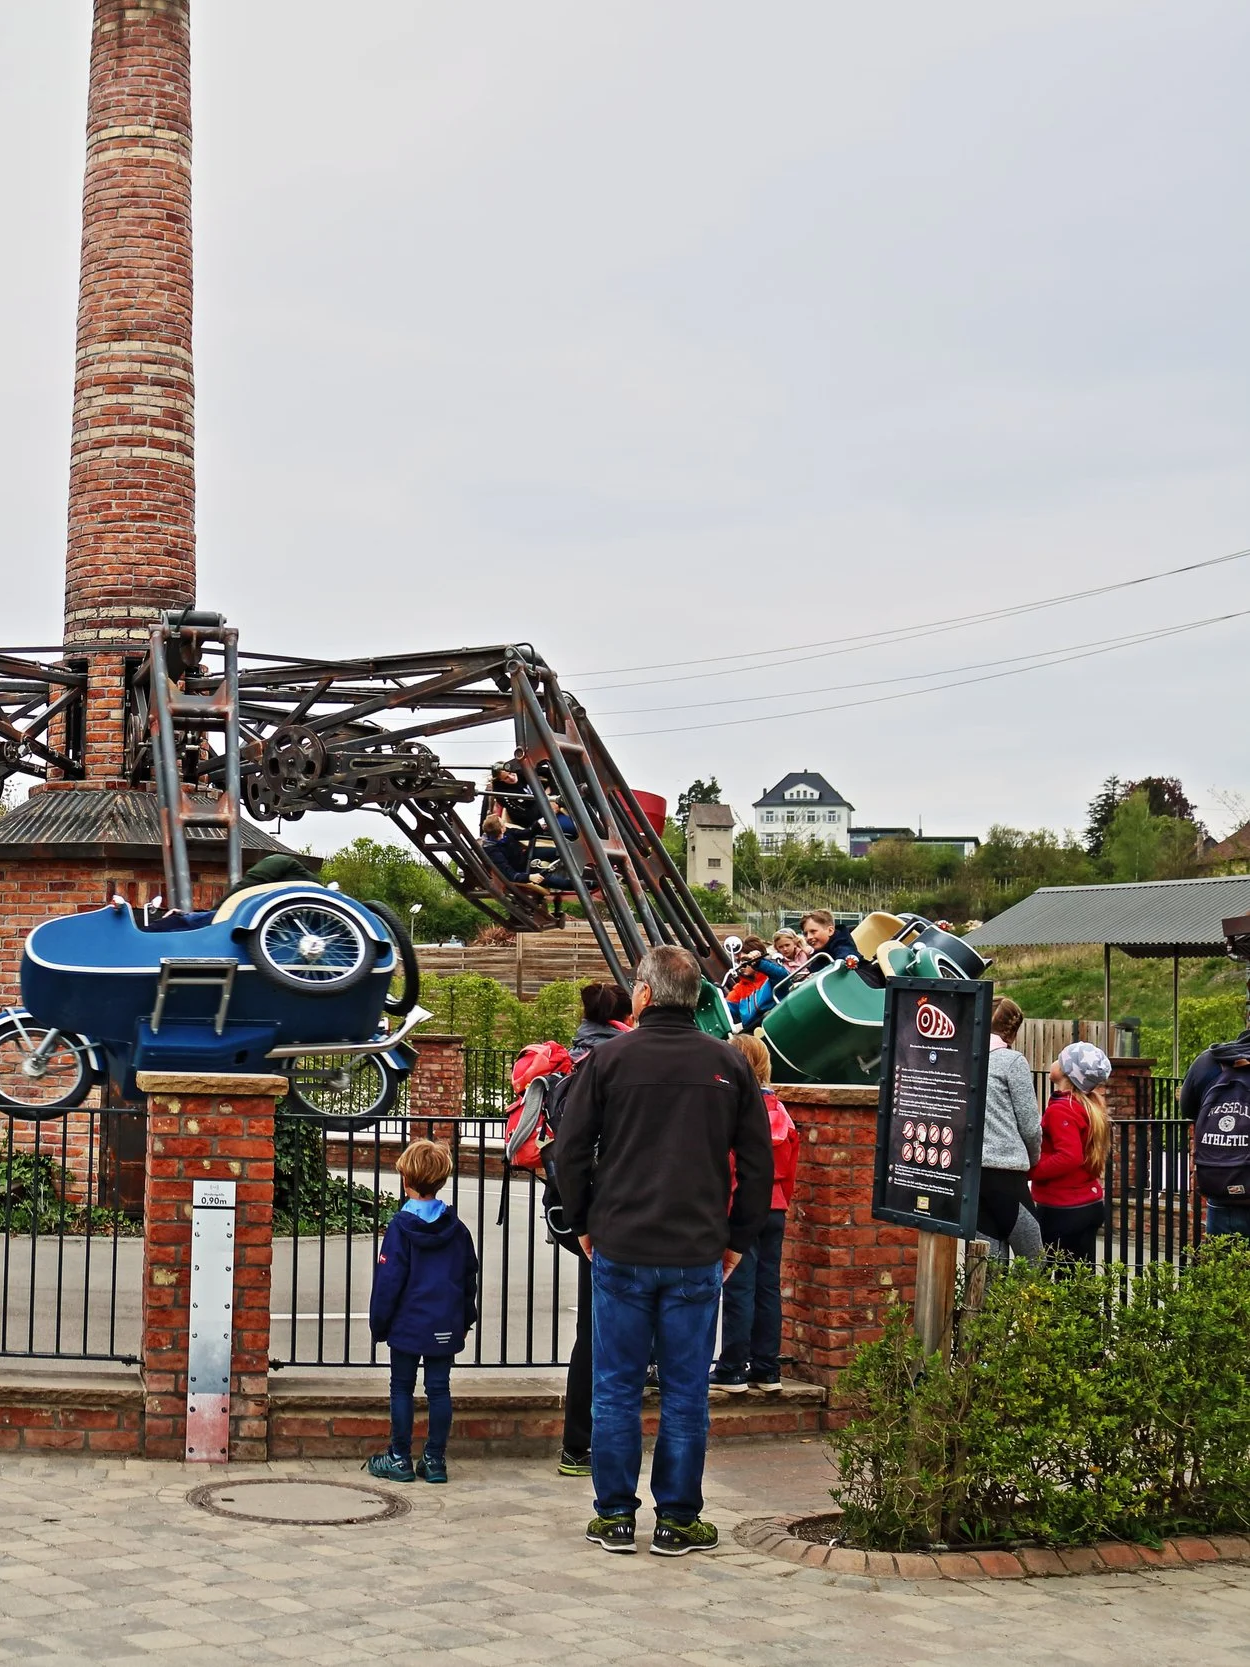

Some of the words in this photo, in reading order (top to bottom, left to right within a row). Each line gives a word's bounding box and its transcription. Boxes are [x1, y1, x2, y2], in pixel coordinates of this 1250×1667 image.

[917, 1006, 953, 1036] OFEN
[1201, 1132, 1249, 1147] ATHLETIC
[201, 1196, 227, 1205] 0,90m
